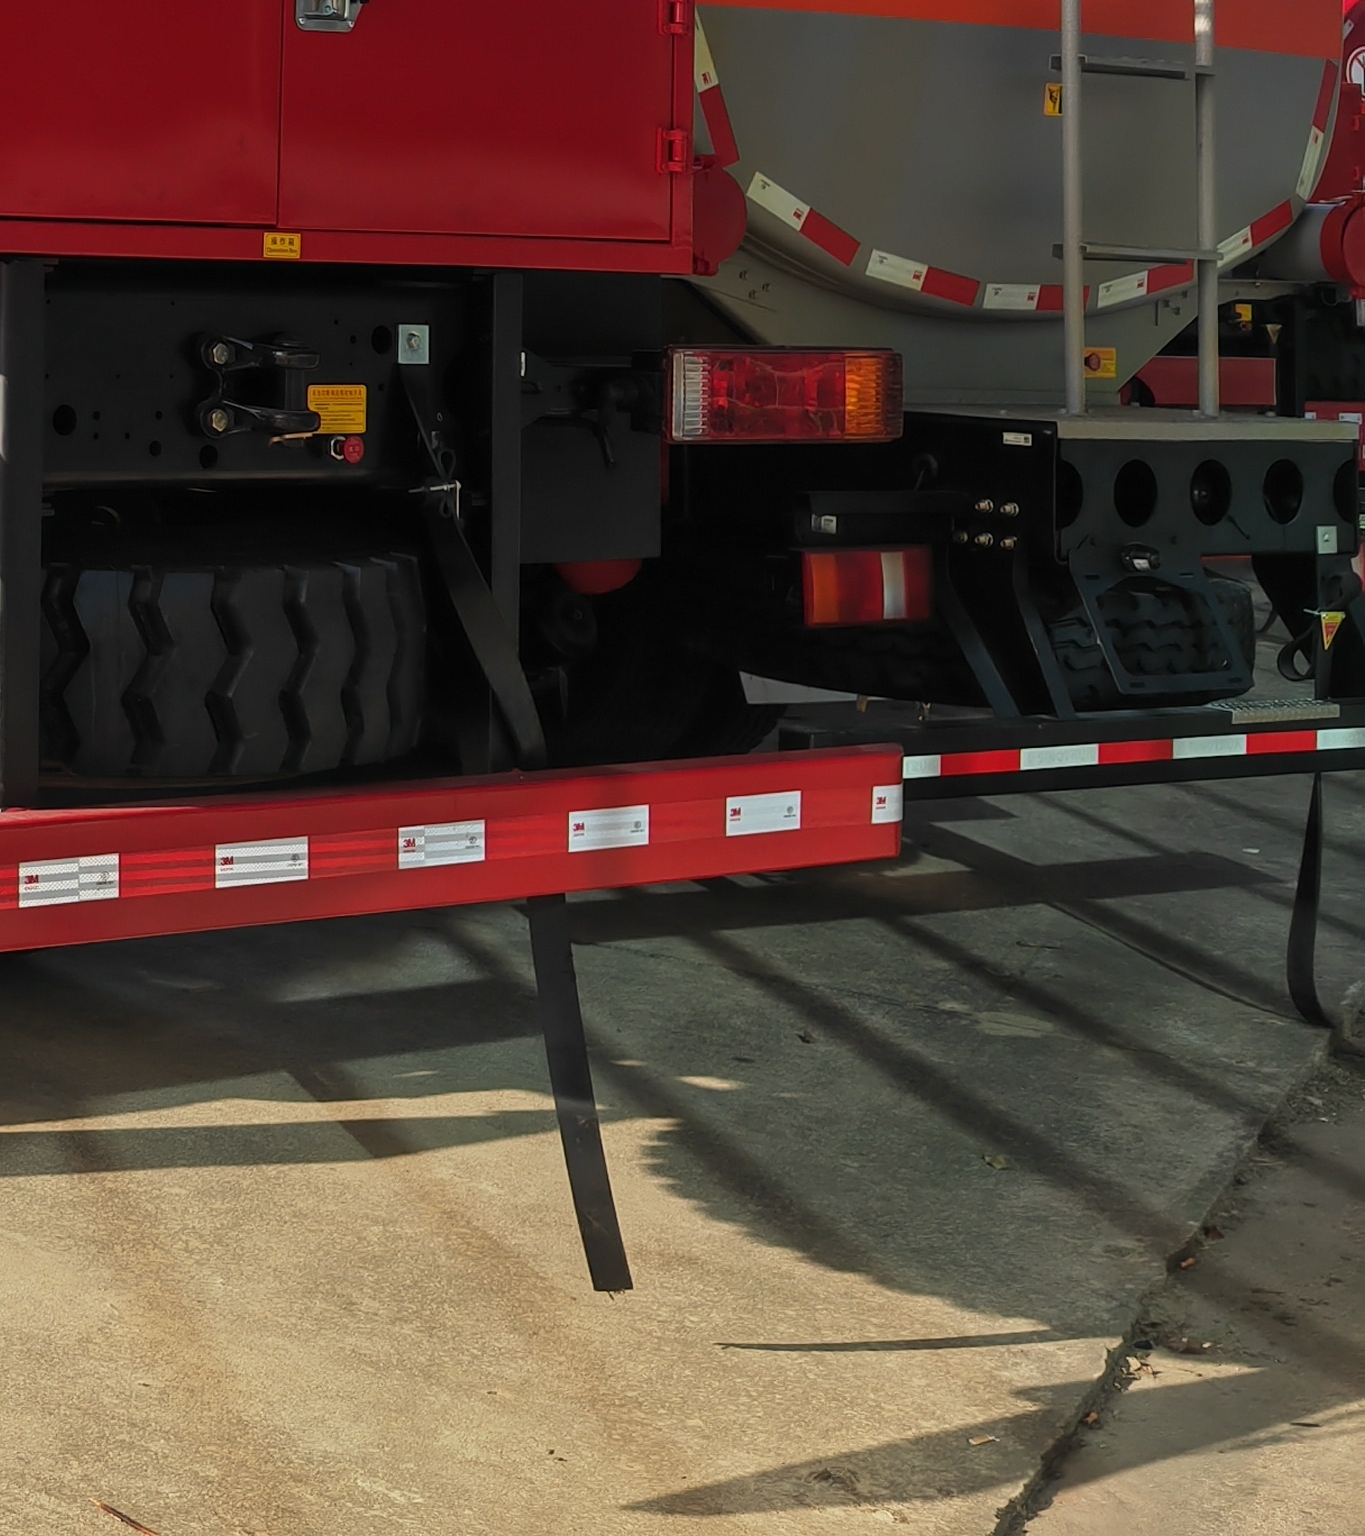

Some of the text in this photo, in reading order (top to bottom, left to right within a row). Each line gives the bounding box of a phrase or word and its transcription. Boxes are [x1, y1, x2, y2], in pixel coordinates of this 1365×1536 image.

[729, 807, 741, 817] 3M
[572, 822, 585, 832] 3M
[403, 838, 416, 848] 3M
[220, 856, 234, 866] 3M
[24, 874, 39, 884] 3M
